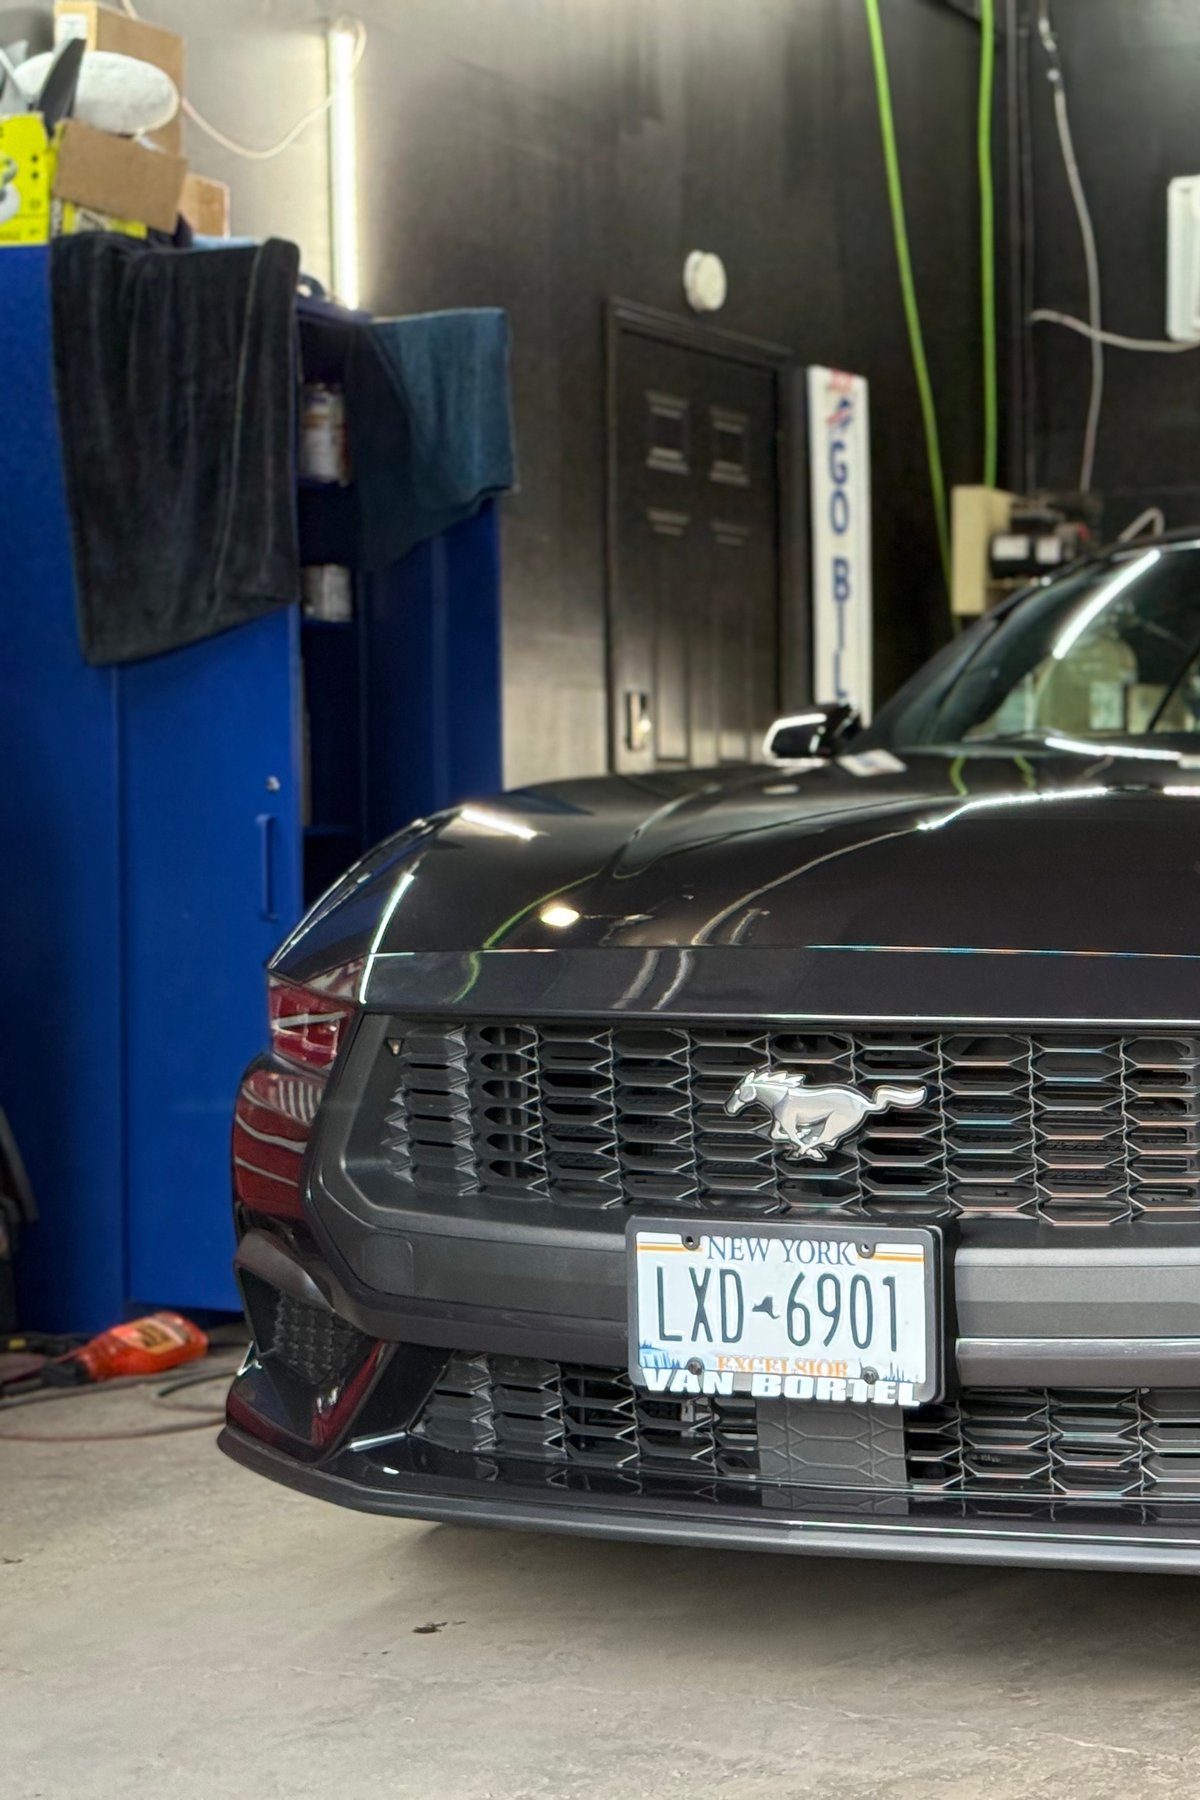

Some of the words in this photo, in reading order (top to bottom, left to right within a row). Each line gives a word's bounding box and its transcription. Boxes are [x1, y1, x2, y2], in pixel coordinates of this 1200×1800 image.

[828, 441, 850, 535] GO
[707, 1236, 770, 1263] NEW
[782, 1239, 856, 1265] YORK
[655, 1265, 745, 1344] LXD
[786, 1271, 898, 1352] 6901
[716, 1354, 849, 1378] EXCELSIOR
[642, 1368, 735, 1396] VAN
[751, 1373, 921, 1407] BORTEL
